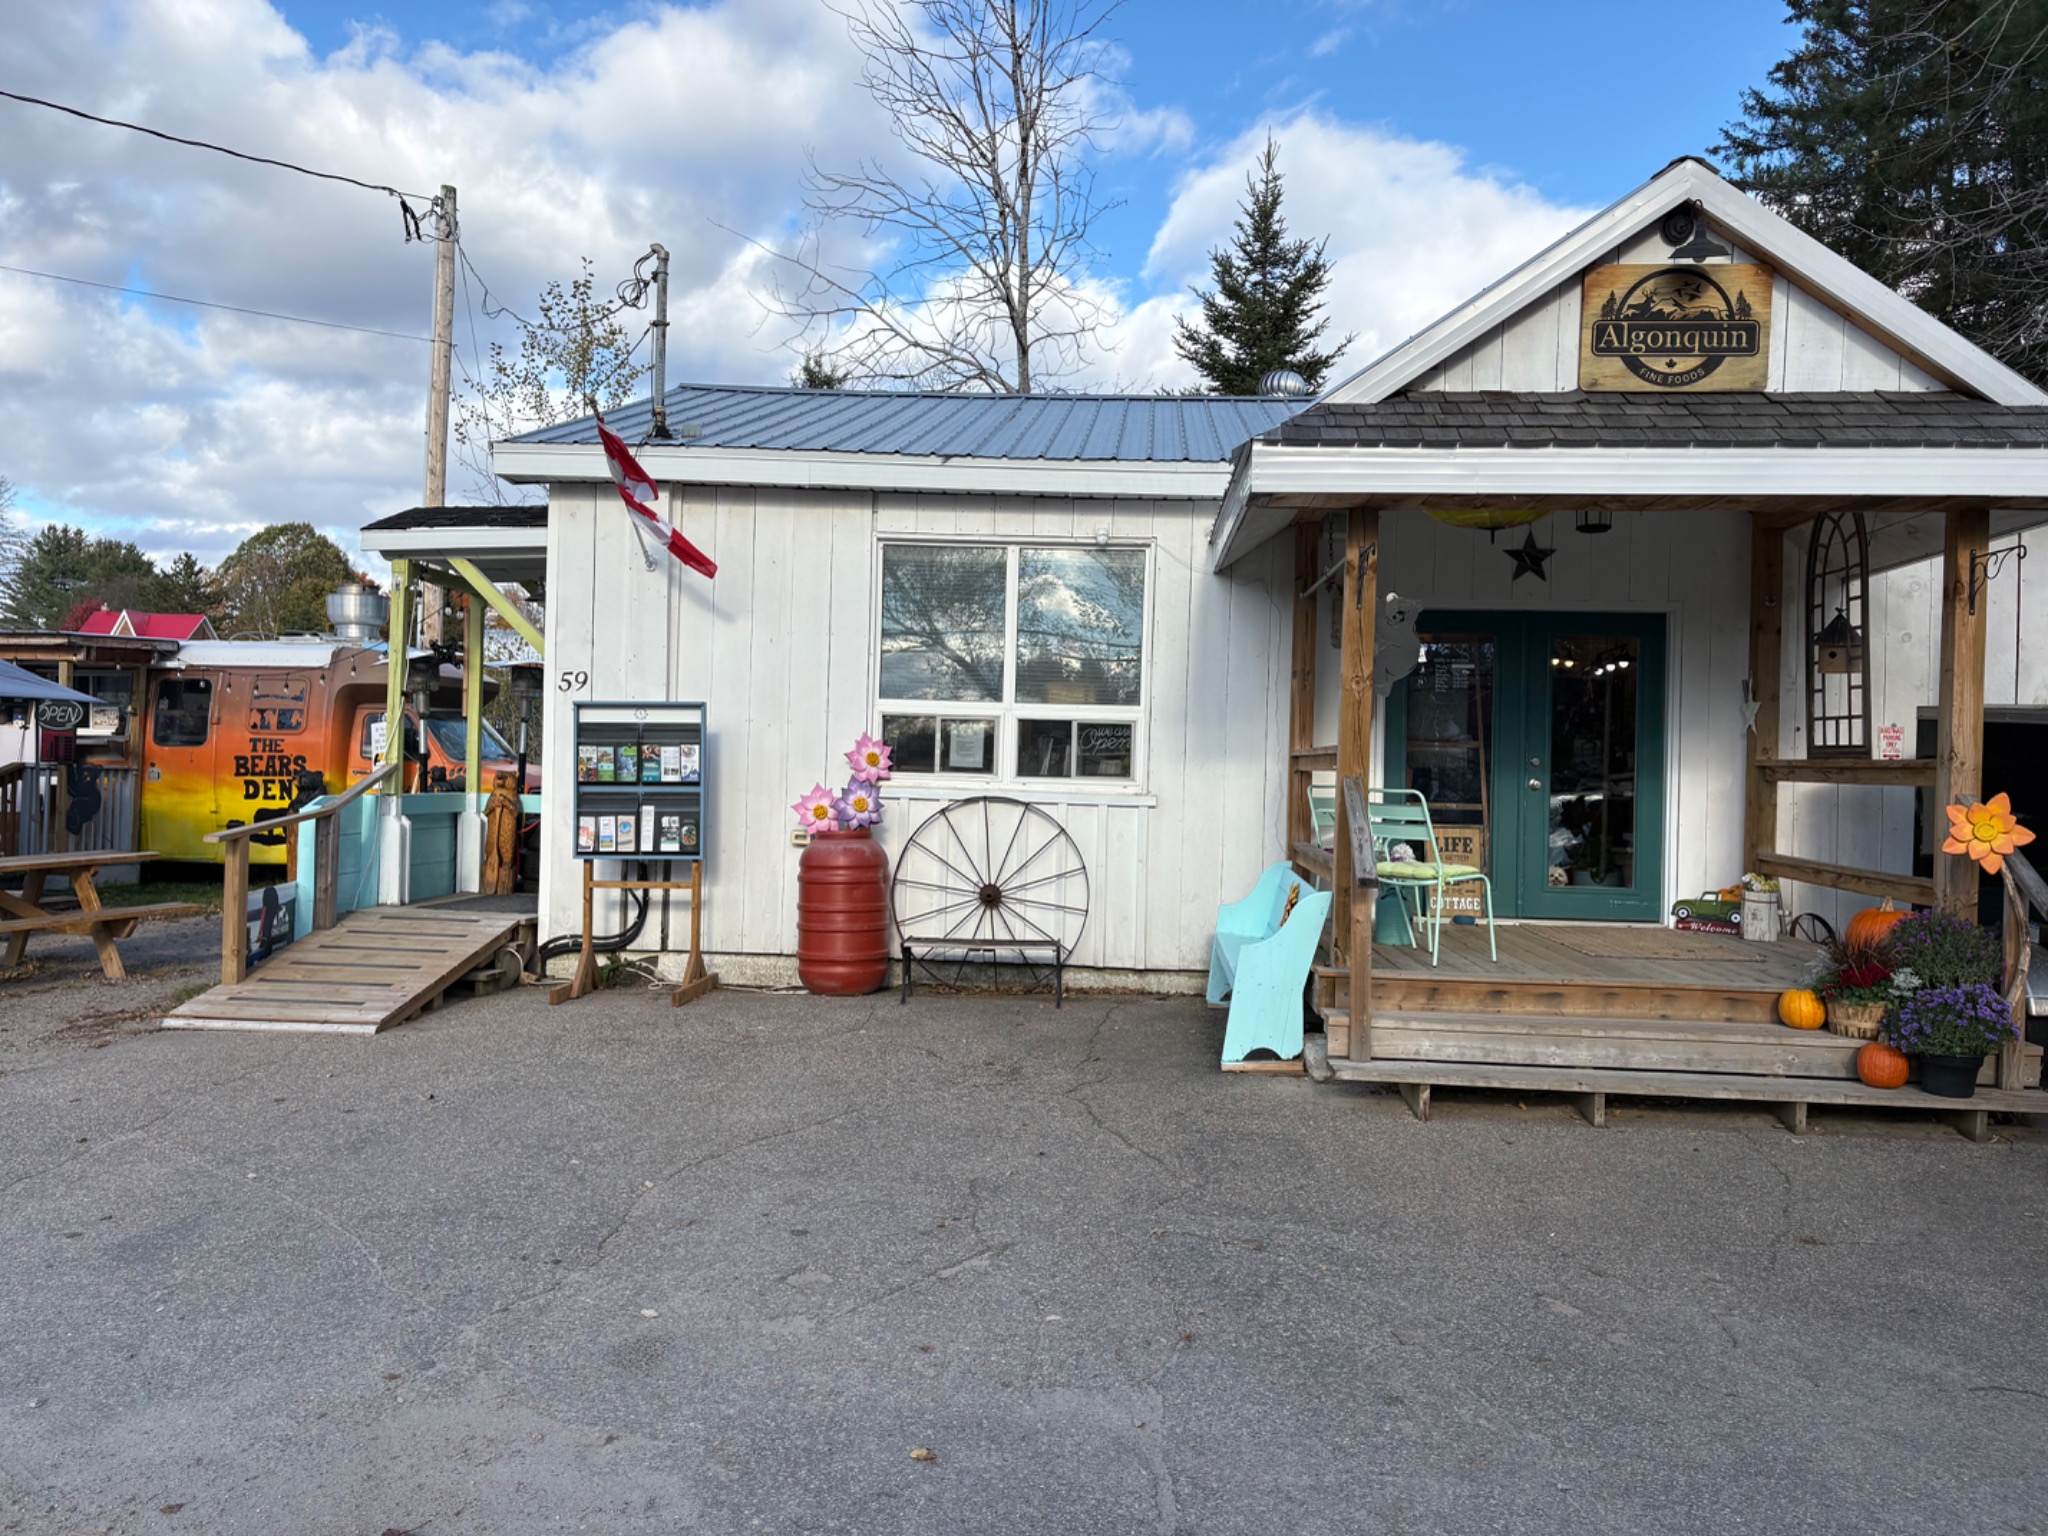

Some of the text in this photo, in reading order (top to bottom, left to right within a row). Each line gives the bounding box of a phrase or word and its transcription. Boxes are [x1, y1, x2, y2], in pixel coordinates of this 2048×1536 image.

[1598, 322, 1749, 354] Algonquin
[1638, 367, 1706, 385] FINE FOODS
[557, 670, 589, 692] 59
[38, 705, 78, 723] OPEN
[1113, 726, 1131, 737] ar
[249, 737, 286, 753] THE
[1079, 726, 1131, 756] Open
[233, 753, 307, 777] BEAR'S
[243, 779, 294, 801] DEN
[1433, 836, 1473, 854] LIFE
[1689, 921, 1738, 935] Welcome
